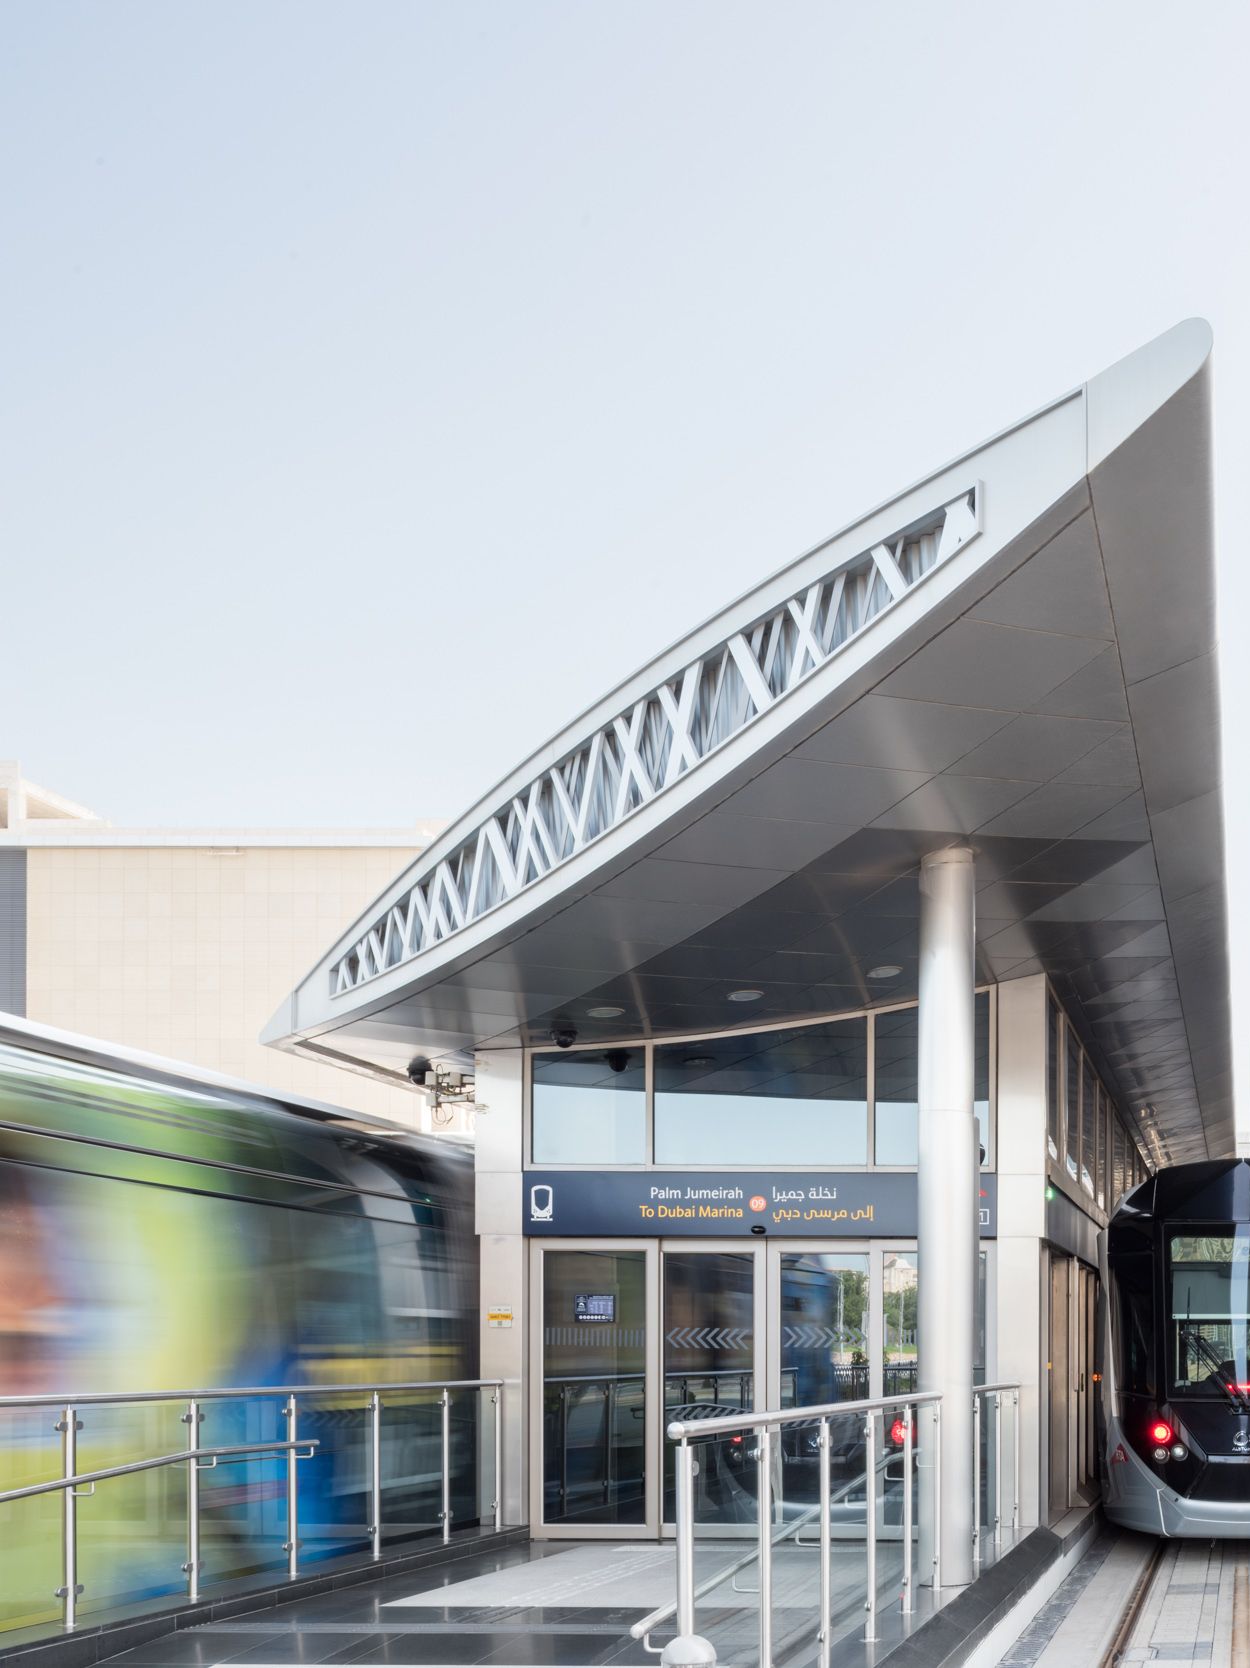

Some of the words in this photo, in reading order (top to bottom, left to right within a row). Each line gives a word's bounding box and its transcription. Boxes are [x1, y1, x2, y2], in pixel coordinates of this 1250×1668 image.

[650, 1187, 681, 1199] Palm
[684, 1187, 743, 1199] Jumeirah
[772, 1186, 805, 1202] جميرا
[809, 1187, 837, 1200] نخلة
[751, 1200, 765, 1209] 09
[639, 1205, 655, 1218] To
[658, 1205, 695, 1218] Dubai
[699, 1205, 743, 1218] Marina
[772, 1209, 801, 1223] دبي
[804, 1209, 848, 1221] مرسى
[851, 1205, 874, 1221] إلى
